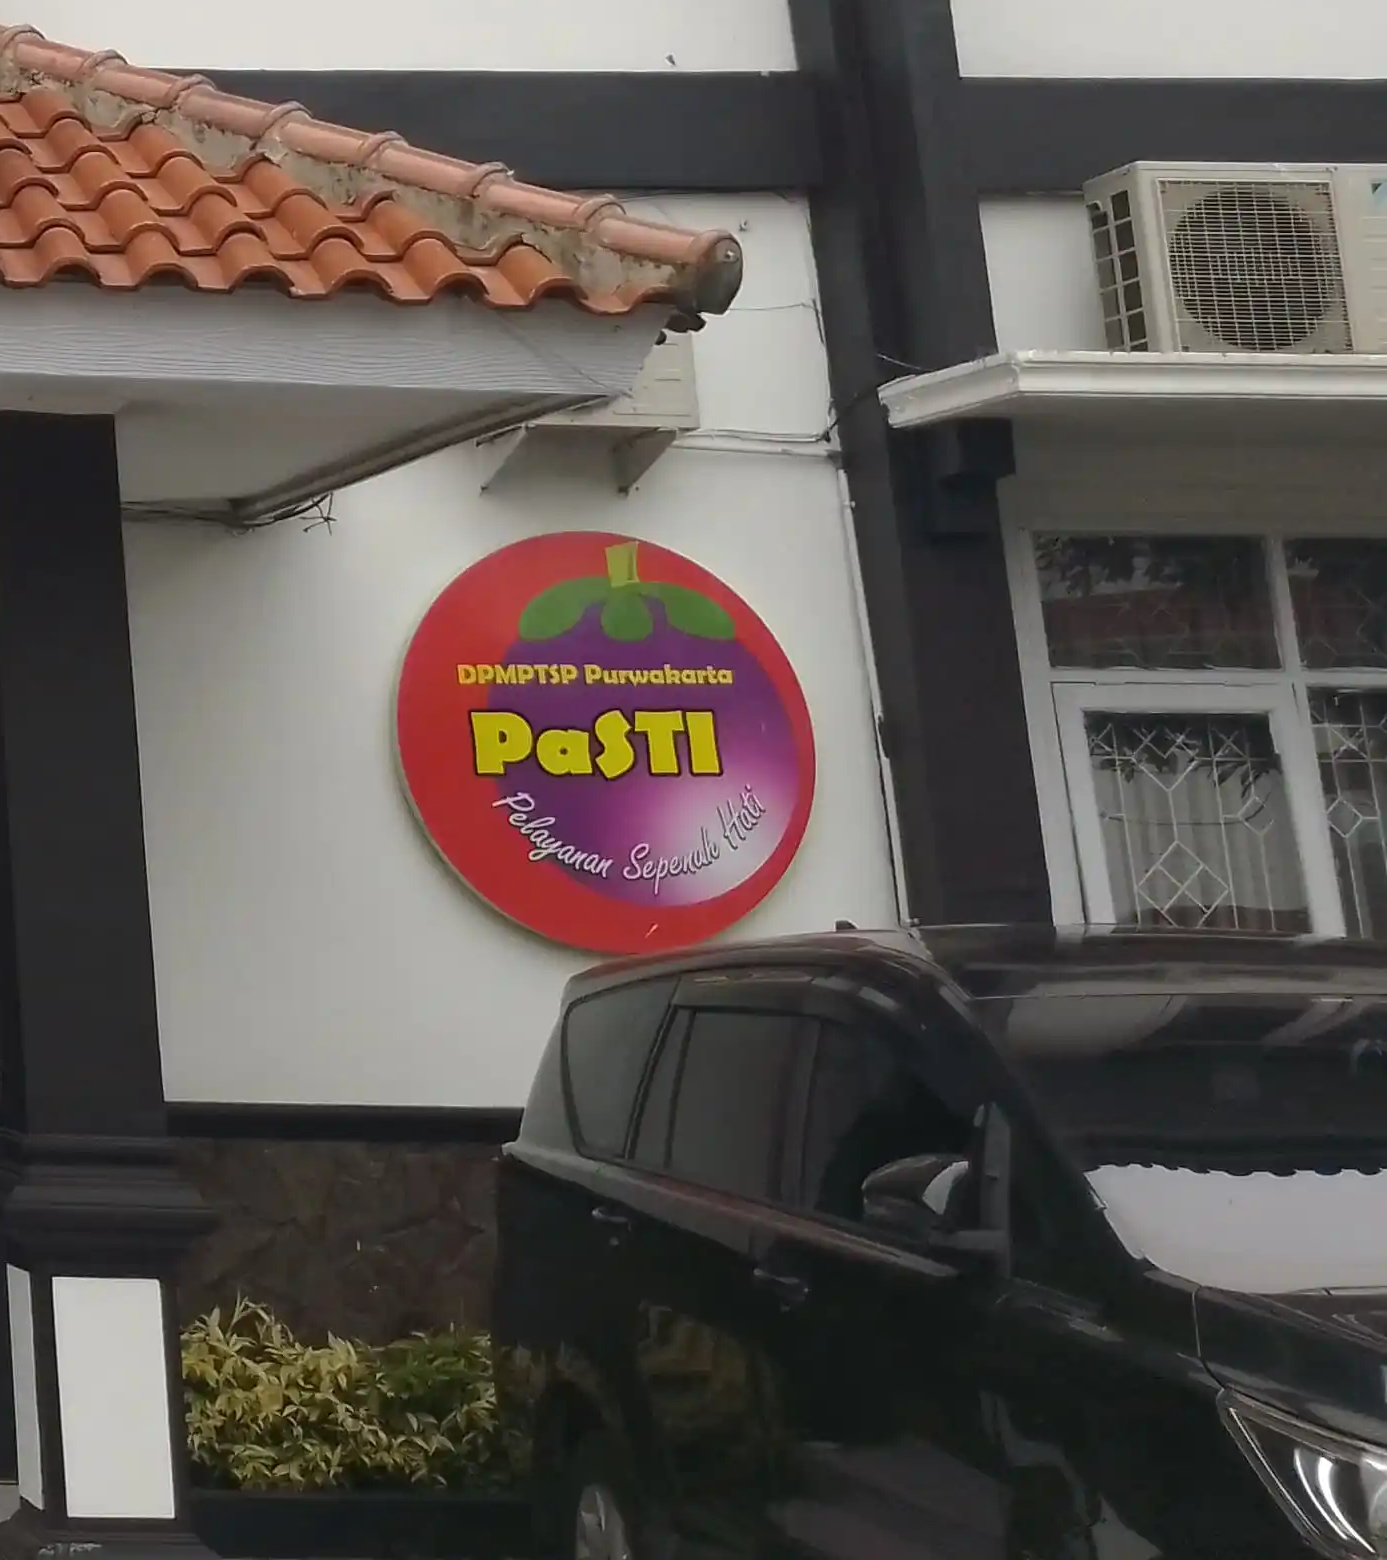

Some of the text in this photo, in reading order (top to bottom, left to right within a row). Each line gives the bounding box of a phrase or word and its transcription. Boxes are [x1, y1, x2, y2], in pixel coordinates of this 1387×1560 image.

[457, 663, 734, 687] DPMPTSP Purwakarta
[470, 708, 723, 780] PaSTI
[491, 783, 767, 896] Pelayanan Sepenuh Hati
